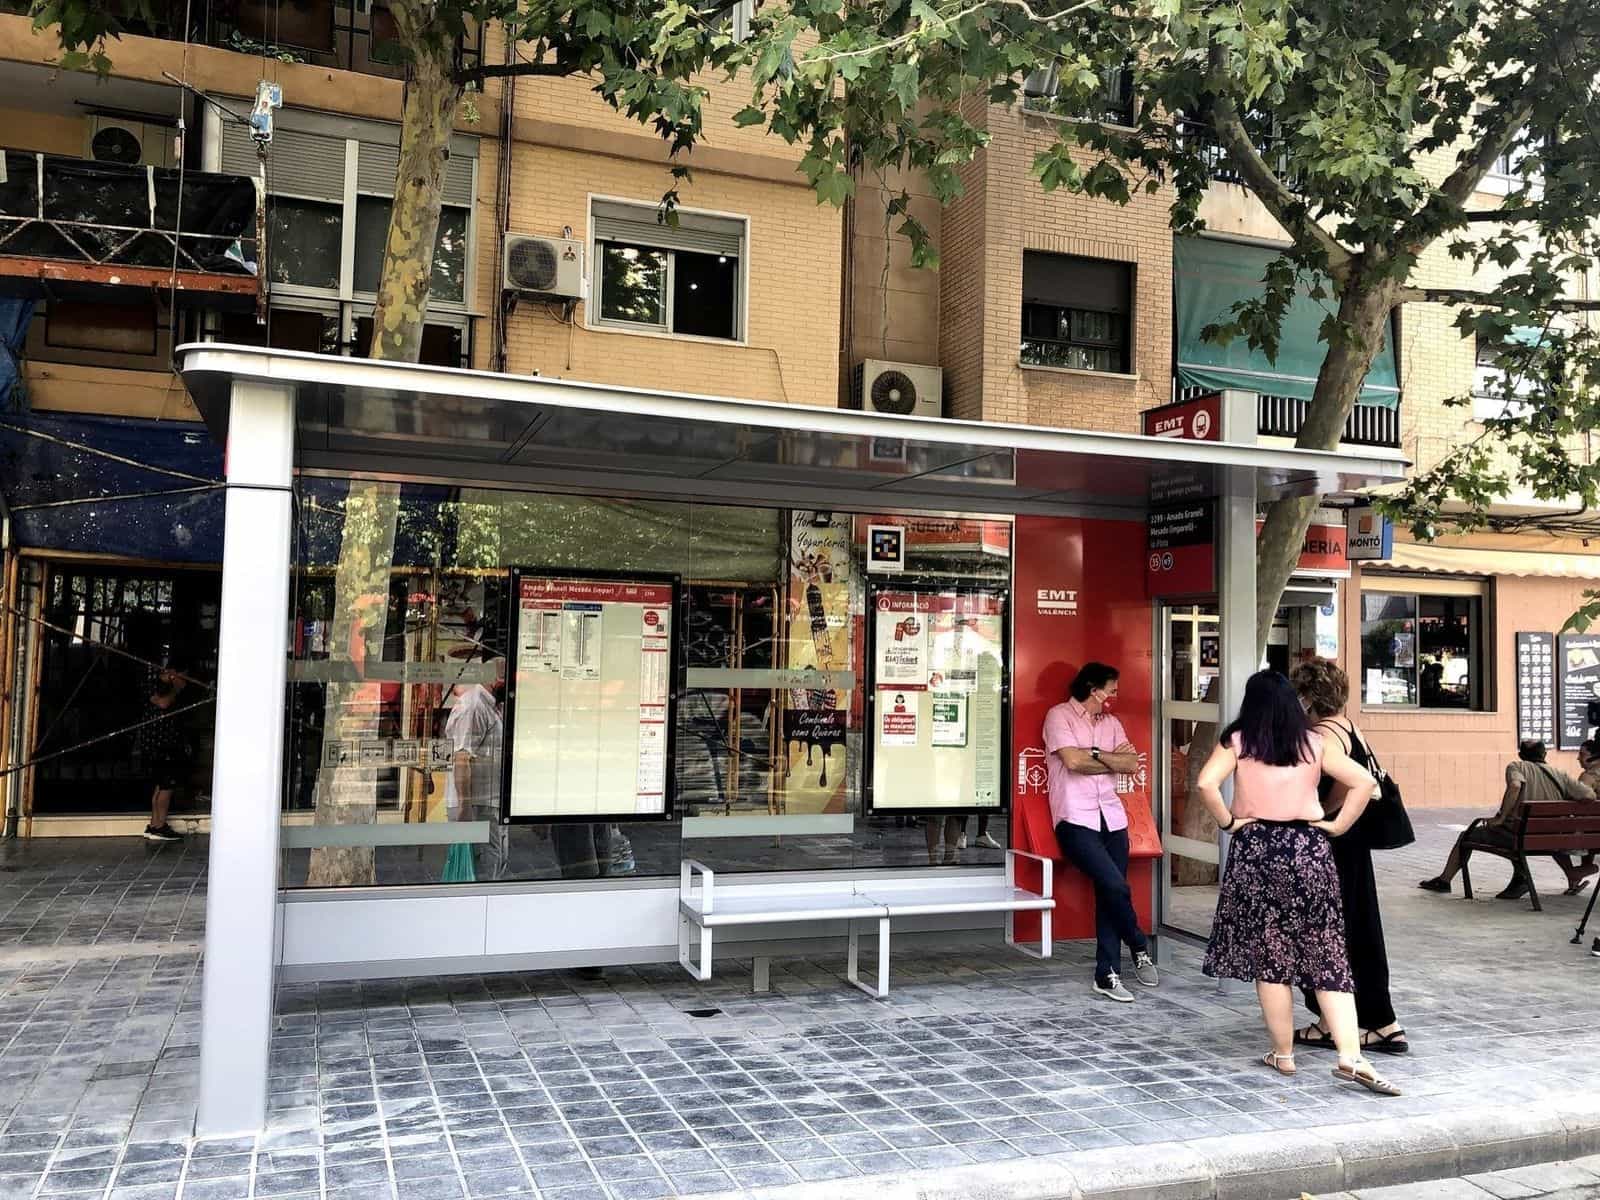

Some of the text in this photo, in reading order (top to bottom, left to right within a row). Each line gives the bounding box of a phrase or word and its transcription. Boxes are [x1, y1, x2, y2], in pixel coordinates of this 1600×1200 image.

[1155, 416, 1184, 432] EMT
[1349, 536, 1381, 548] MONTÓ
[1037, 589, 1078, 600] EMT
